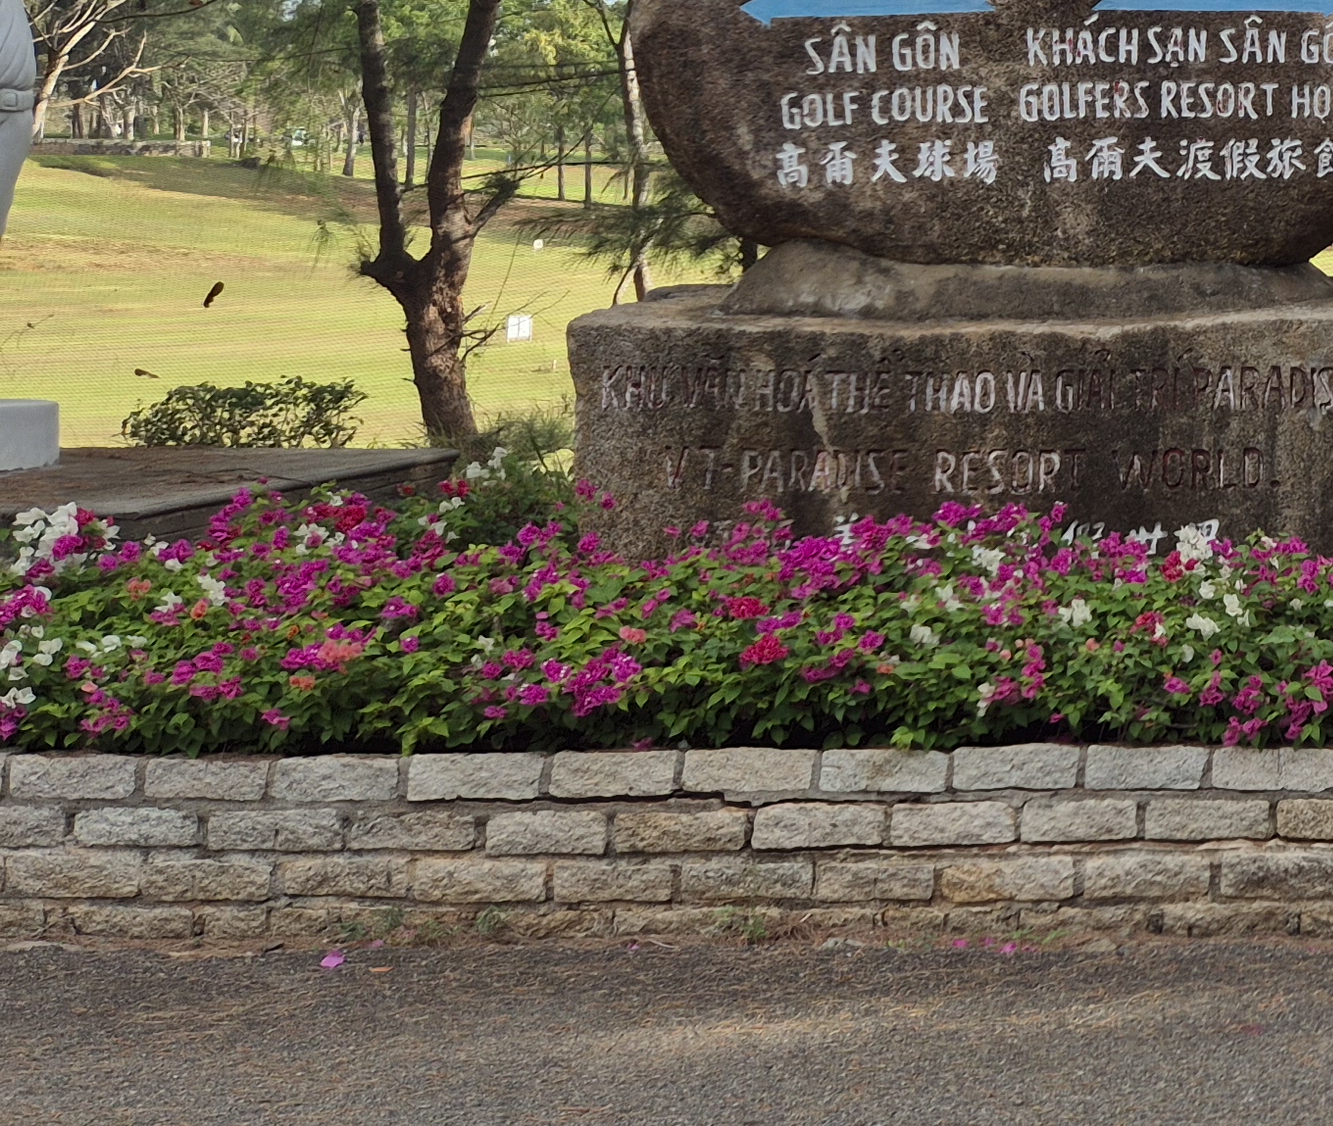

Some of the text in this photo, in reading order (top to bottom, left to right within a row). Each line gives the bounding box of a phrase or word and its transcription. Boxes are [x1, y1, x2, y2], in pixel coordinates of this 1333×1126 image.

[804, 20, 960, 74] SÂN GÔN
[1026, 14, 1138, 67] KHÁCH
[1147, 26, 1207, 68] SẠN
[1219, 15, 1286, 64] SÂN
[780, 83, 989, 130] GOLF COURSE
[1019, 80, 1149, 122] GOLFERS
[1160, 80, 1279, 120] RESORT
[776, 139, 999, 188] 高爾夫球場
[601, 365, 672, 412] KHU
[904, 371, 997, 415] THAO
[934, 447, 1086, 496] RESORT
